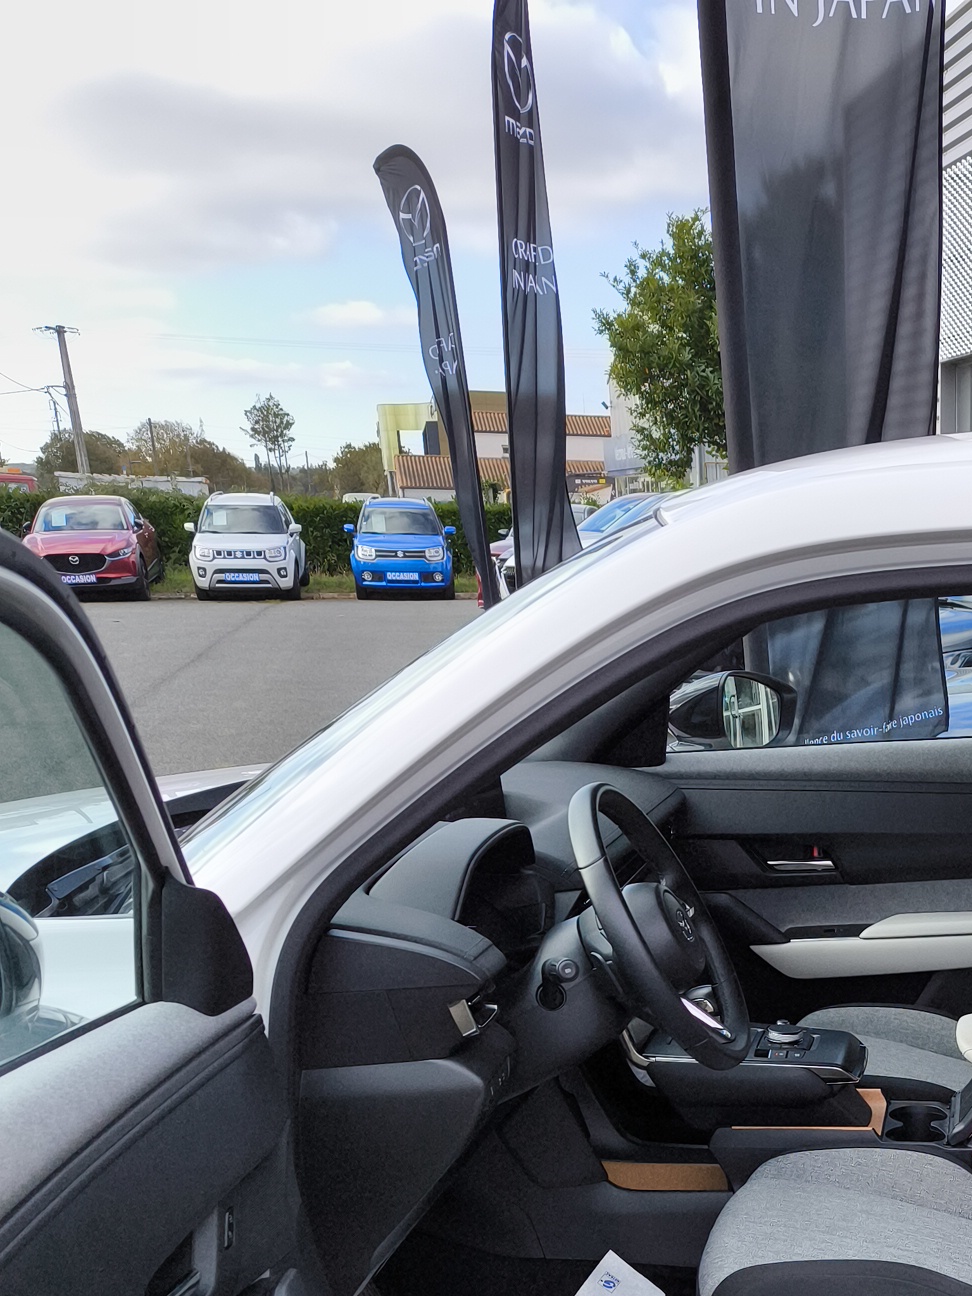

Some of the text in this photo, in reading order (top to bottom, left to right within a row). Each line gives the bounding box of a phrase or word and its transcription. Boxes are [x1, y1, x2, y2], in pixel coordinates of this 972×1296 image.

[512, 238, 554, 266] CRAFD
[61, 574, 97, 583] OCCASION
[225, 572, 260, 581] OCCASION
[386, 572, 419, 580] OCCASION
[830, 730, 844, 743] du
[845, 720, 898, 739] savoir-faire
[899, 705, 944, 728] japonais
